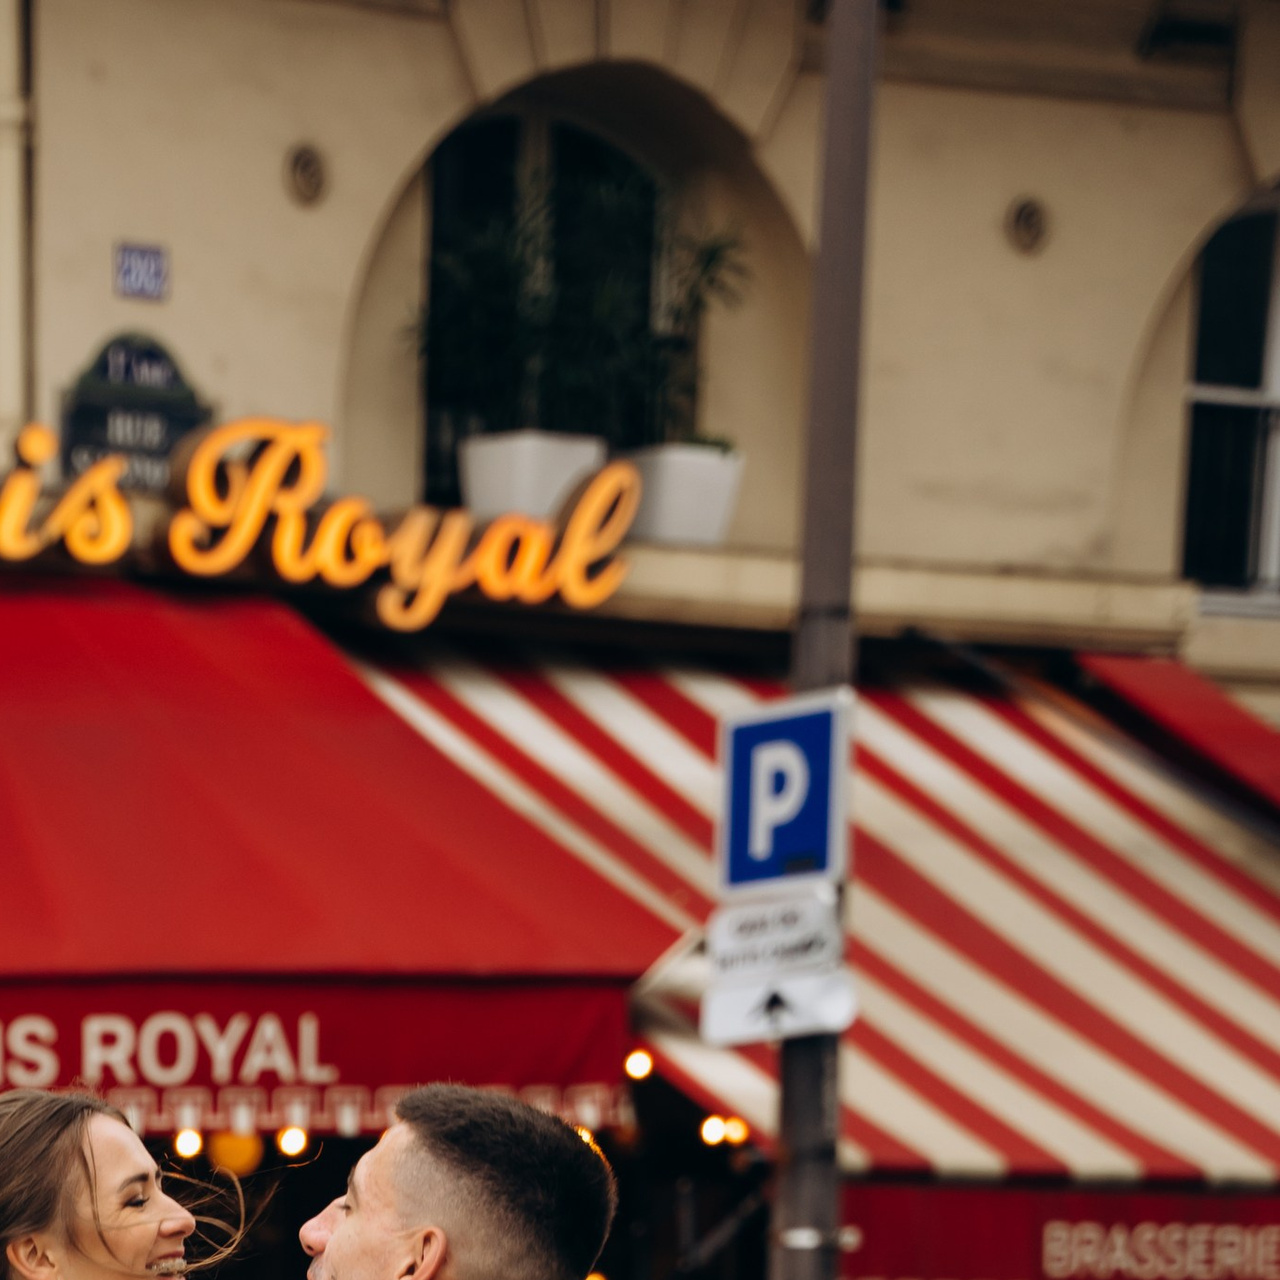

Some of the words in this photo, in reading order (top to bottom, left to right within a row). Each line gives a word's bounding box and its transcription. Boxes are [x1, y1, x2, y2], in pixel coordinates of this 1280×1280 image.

[169, 418, 641, 631] Royal
[749, 740, 810, 861] P
[81, 1012, 338, 1086] ROYAL
[1043, 1221, 1280, 1280] BRASSERIE
